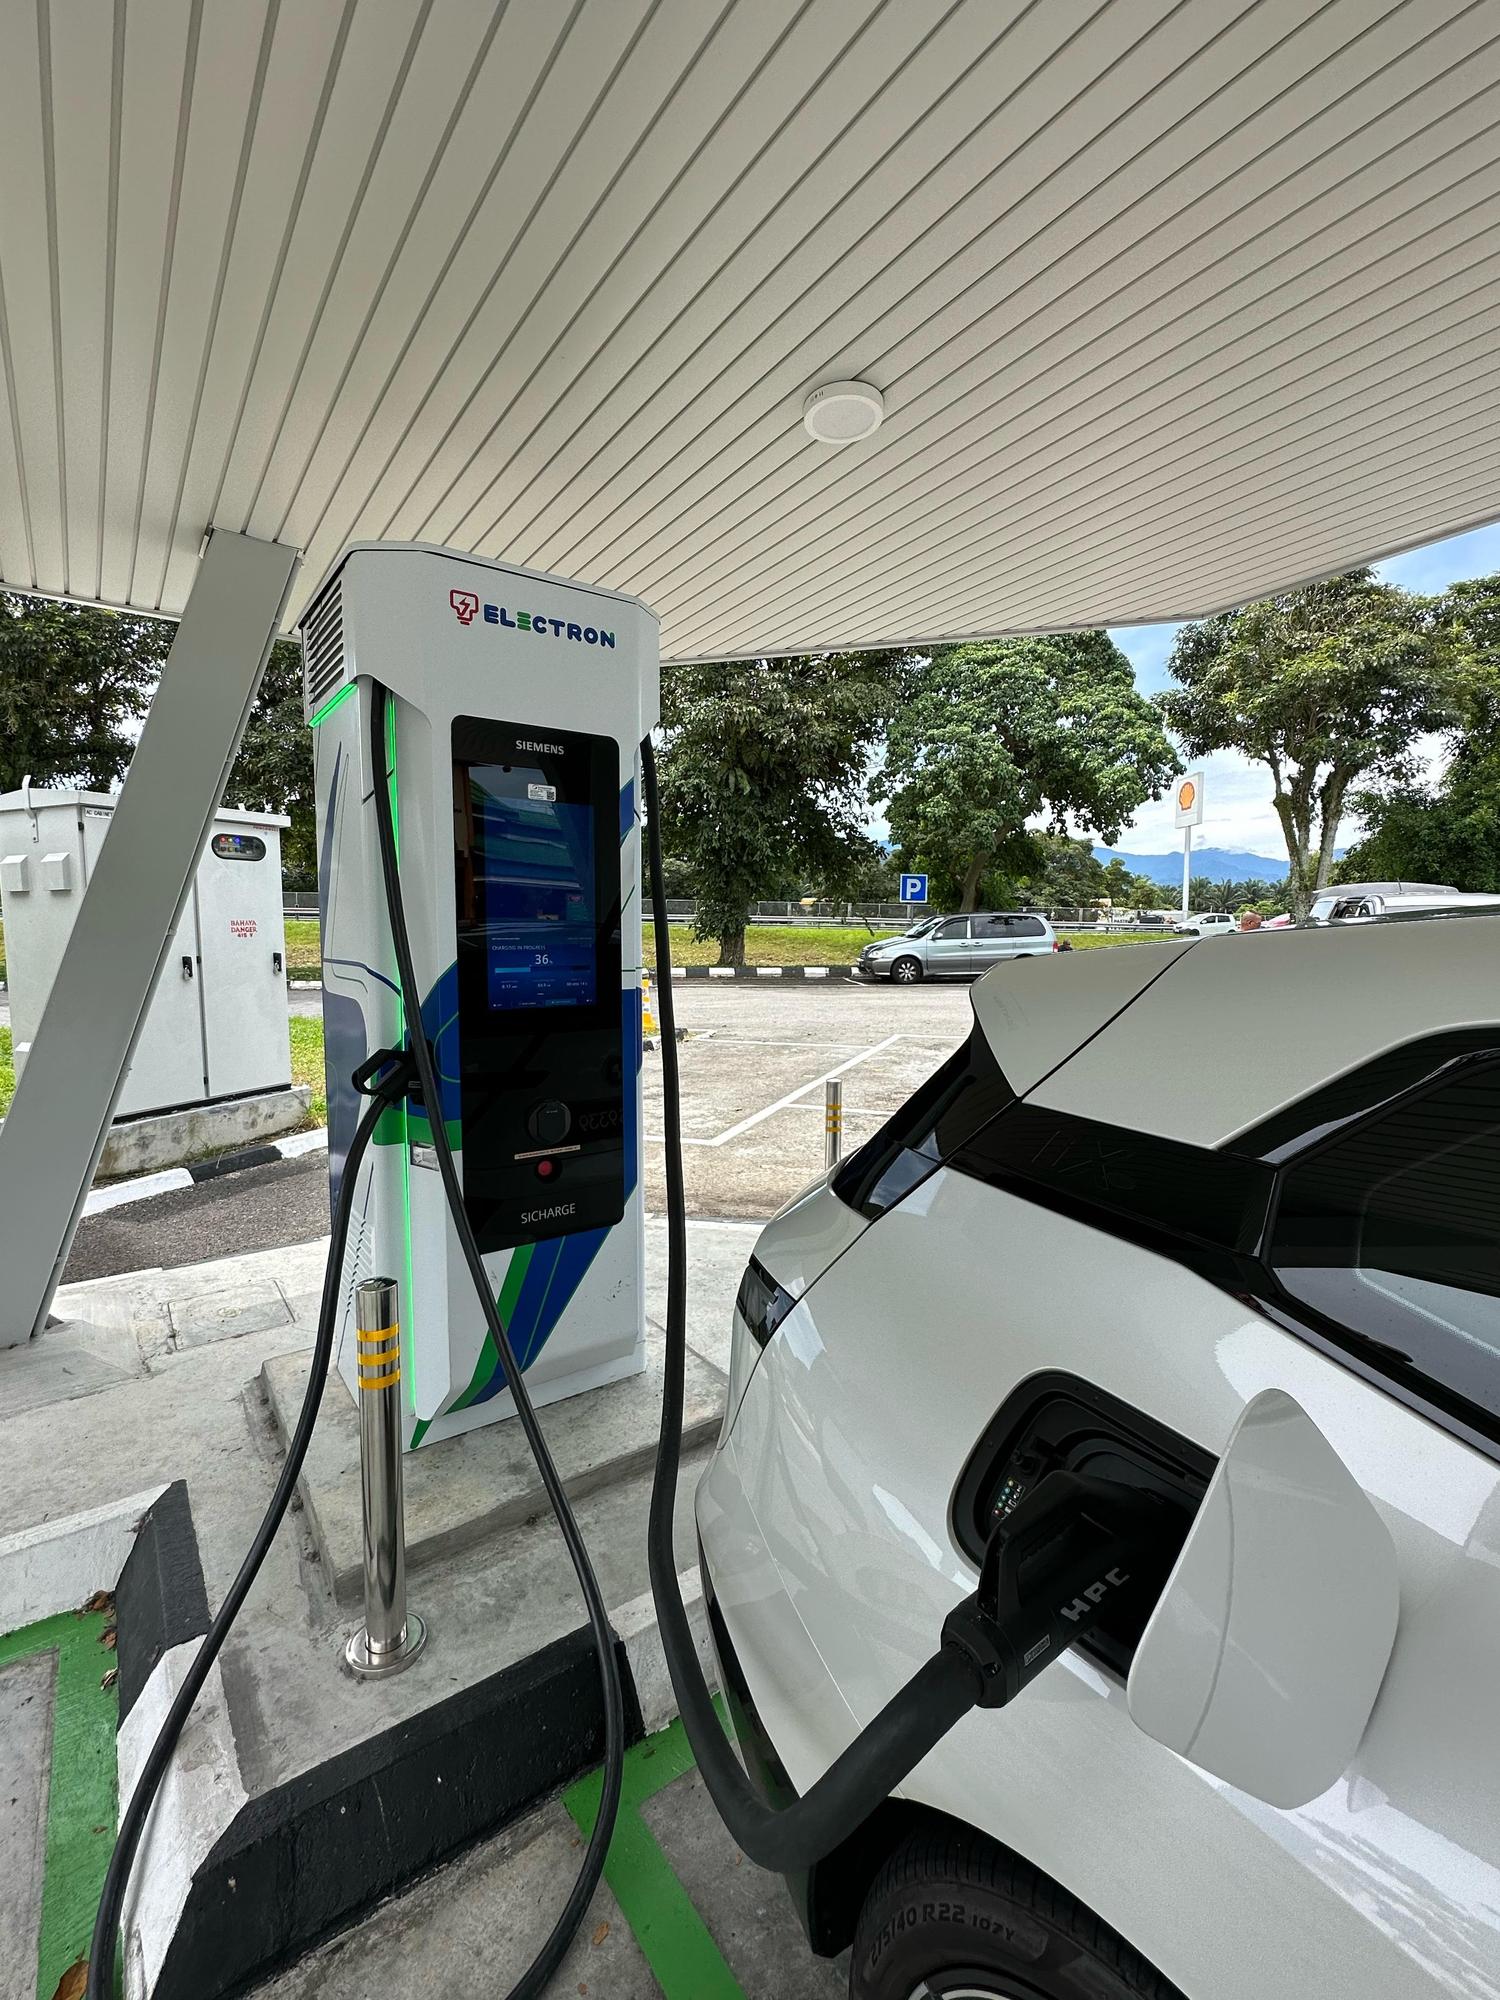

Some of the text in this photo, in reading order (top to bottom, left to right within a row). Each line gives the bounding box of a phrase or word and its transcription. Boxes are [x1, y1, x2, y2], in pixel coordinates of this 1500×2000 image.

[483, 603, 616, 649] ELECTRON
[515, 740, 565, 755] SIEMENS
[906, 878, 921, 900] P
[520, 1202, 577, 1225] SICHARGE
[1060, 1567, 1130, 1622] HPC
[922, 1902, 966, 1925] R22
